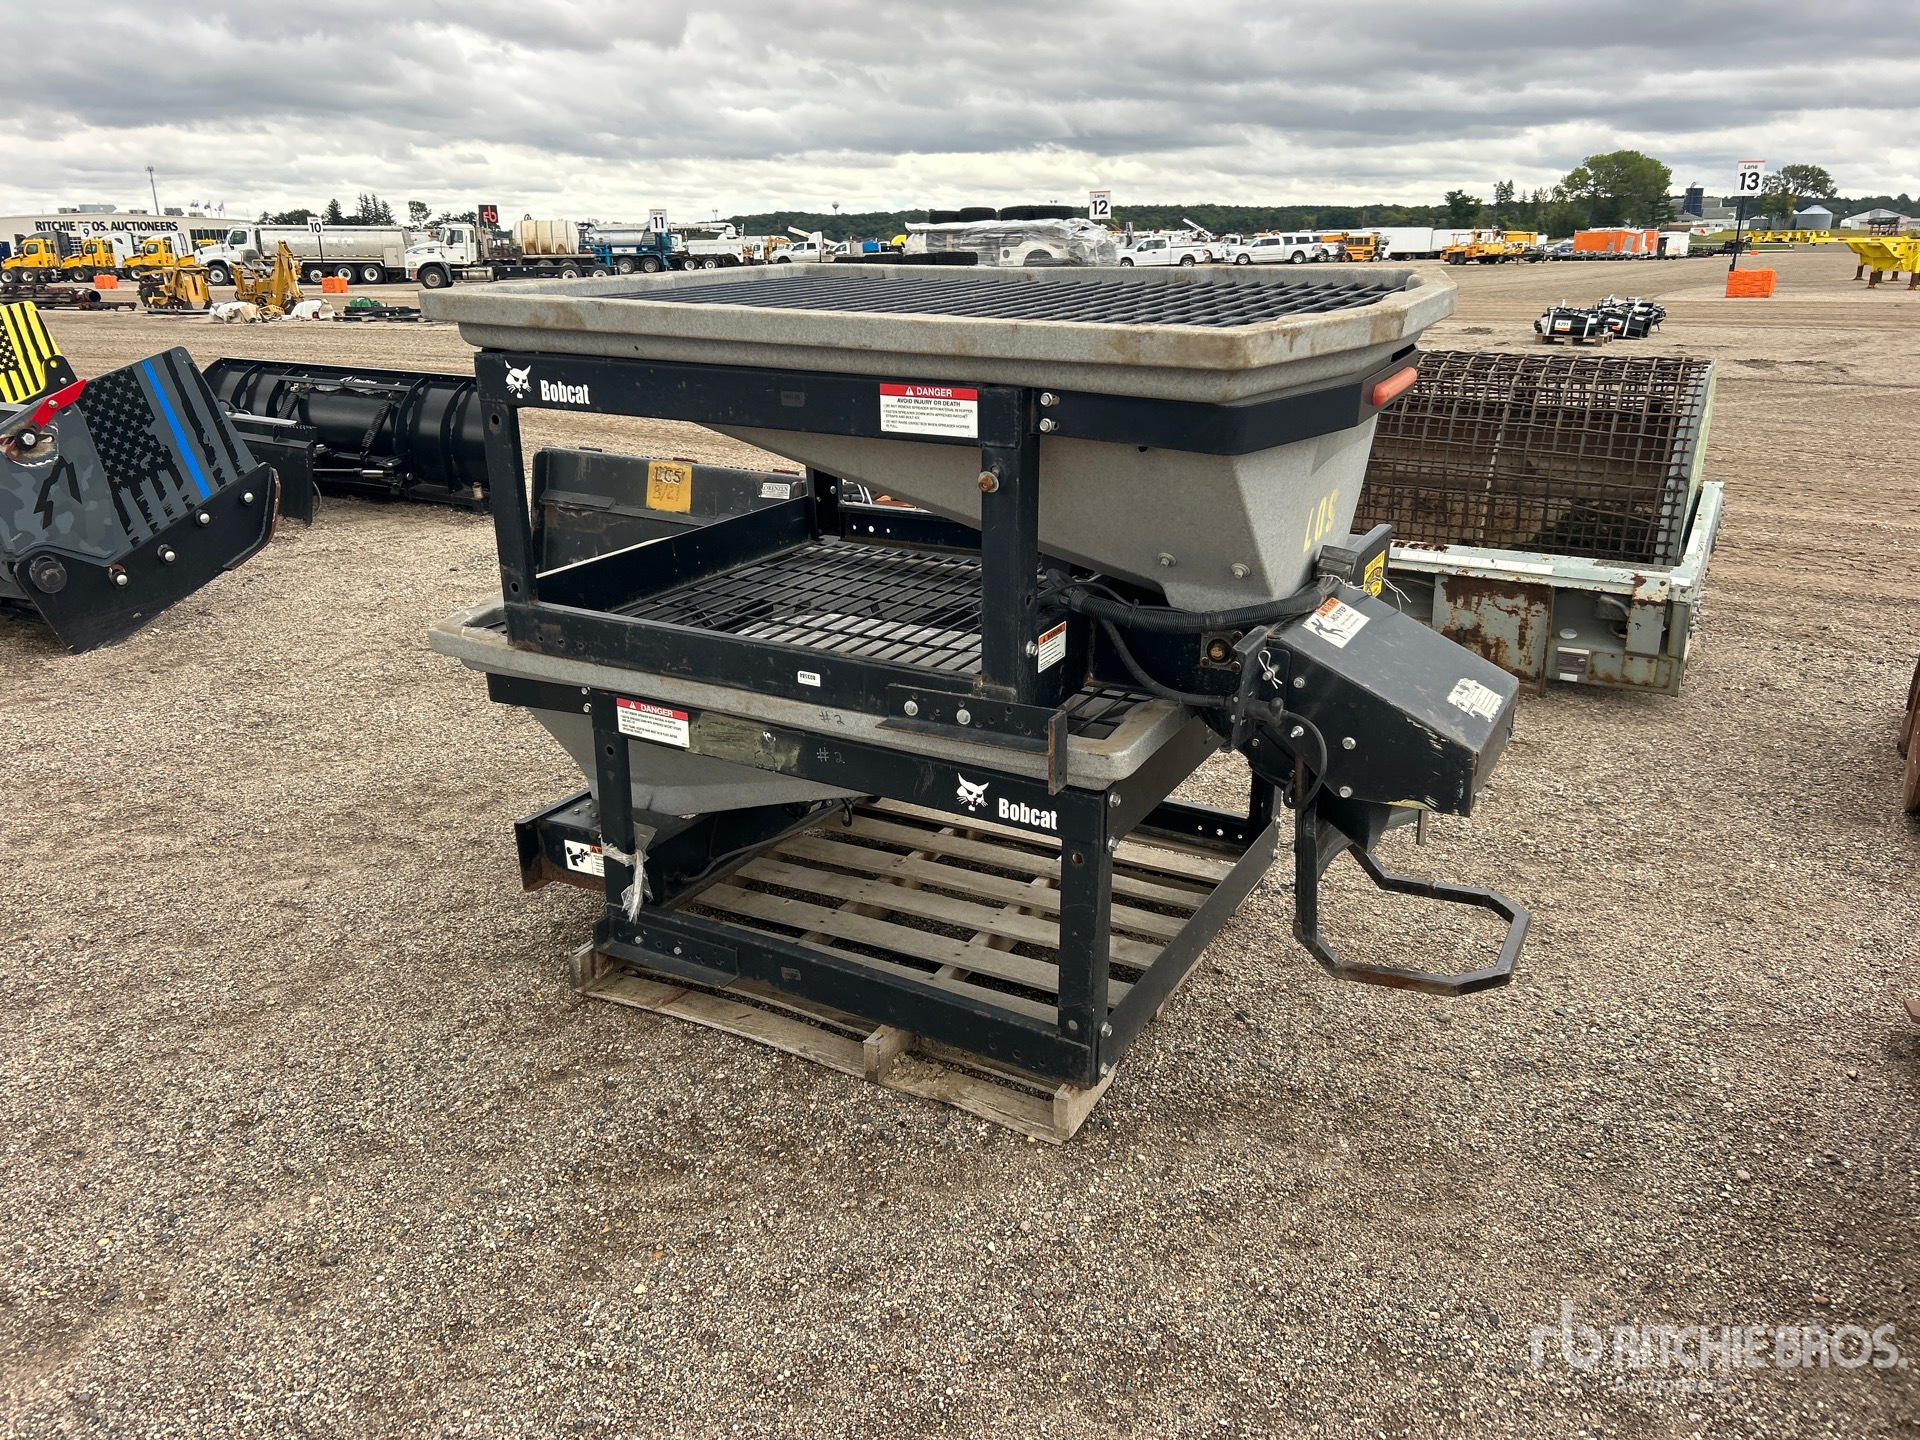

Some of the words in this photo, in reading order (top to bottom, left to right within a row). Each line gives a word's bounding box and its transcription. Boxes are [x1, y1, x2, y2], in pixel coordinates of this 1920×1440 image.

[1739, 172, 1760, 190] 13
[1092, 200, 1108, 215] 12
[35, 221, 76, 232] RITCHIE
[78, 221, 108, 232] OS.
[111, 221, 178, 232] AUCTIONEERS
[309, 222, 321, 233] 10
[653, 216, 664, 229] 11
[83, 228, 90, 238] 9
[540, 380, 590, 404] Bobcat
[916, 387, 952, 397] DANGER
[640, 704, 674, 717] DANGER
[998, 798, 1058, 830] Bobcat
